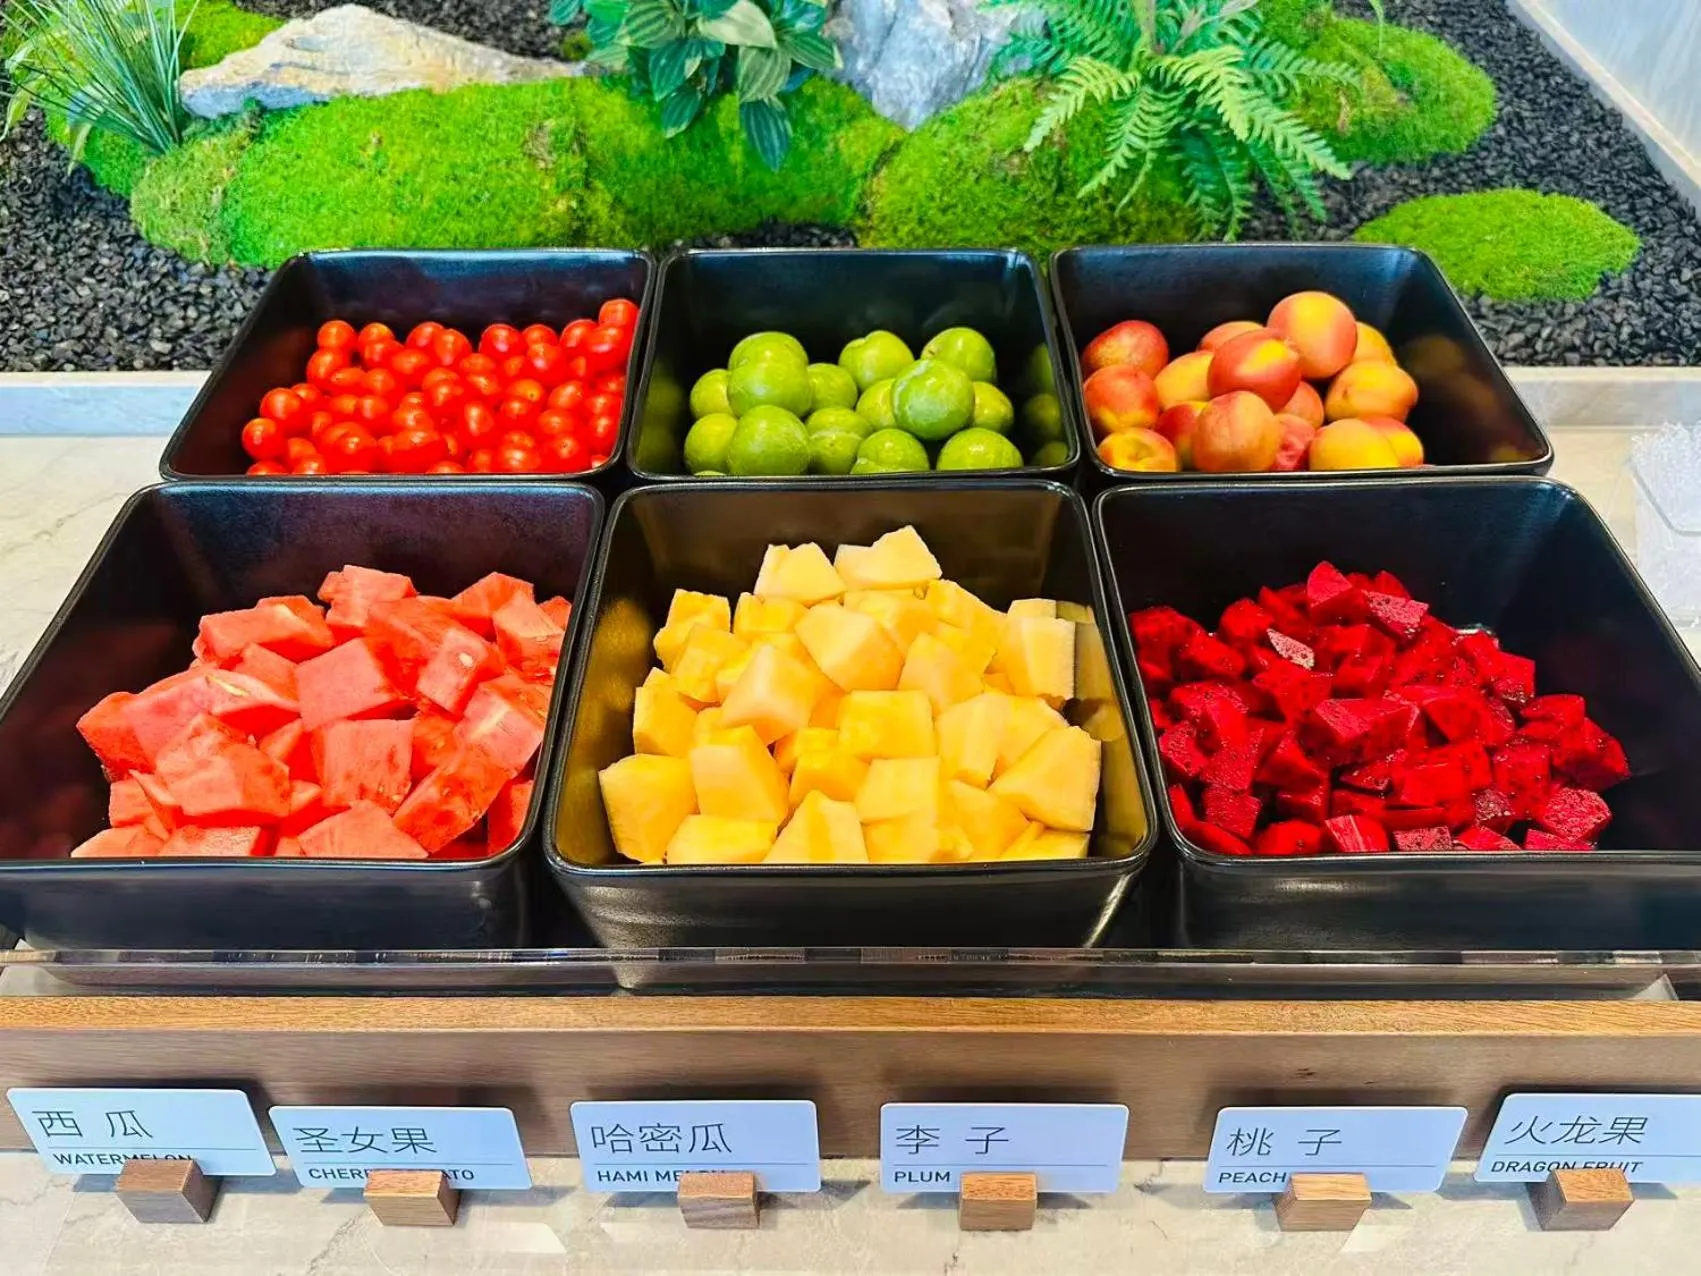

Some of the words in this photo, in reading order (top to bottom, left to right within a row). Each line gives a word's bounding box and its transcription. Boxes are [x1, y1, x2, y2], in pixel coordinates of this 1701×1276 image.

[32, 1110, 153, 1138] 西瓜
[591, 1123, 732, 1153] 哈密瓜
[1504, 1115, 1648, 1145] 火龙果
[293, 1126, 437, 1154] 圣女果
[896, 1125, 1009, 1155] 李子
[1226, 1127, 1342, 1156] 桃子
[308, 1168, 372, 1180] CHER
[597, 1170, 649, 1182] HAMI
[894, 1171, 951, 1183] PLUM
[1218, 1172, 1287, 1183] PEACH
[1491, 1160, 1577, 1173] DRAGON
